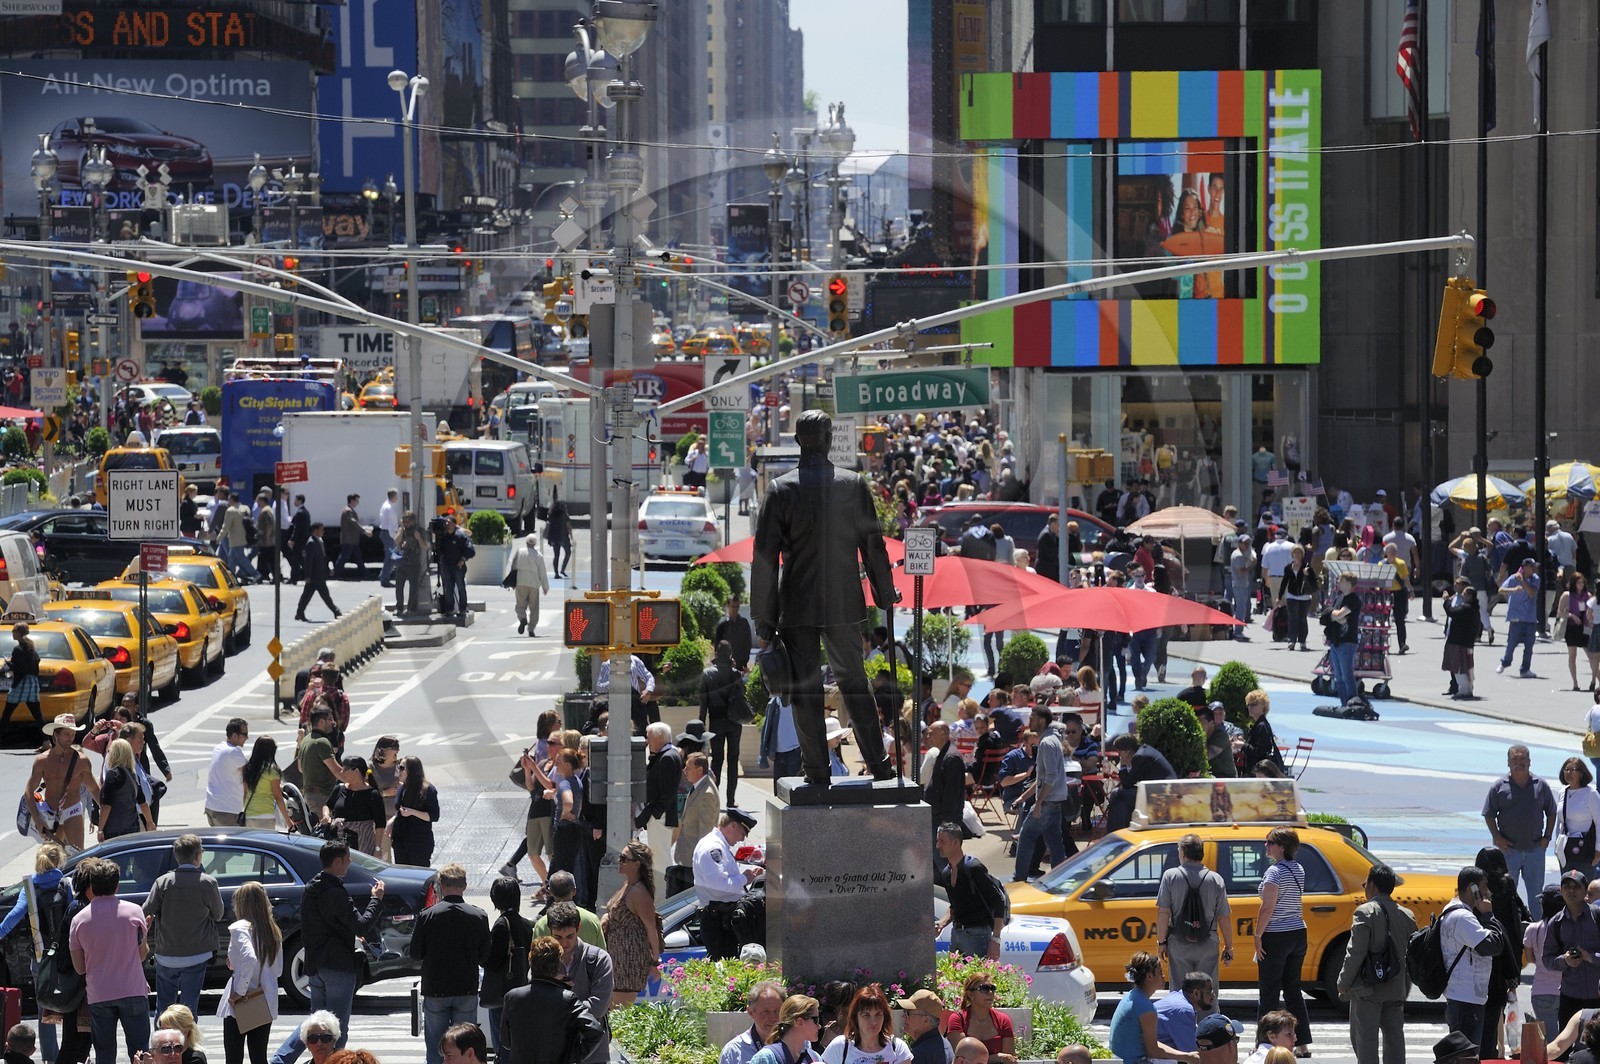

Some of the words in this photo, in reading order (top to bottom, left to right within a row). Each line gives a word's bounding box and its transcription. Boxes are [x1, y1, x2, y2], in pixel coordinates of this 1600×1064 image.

[1, 2, 60, 12] SHERWOOD
[112, 11, 170, 47] AND
[41, 73, 79, 95] All
[94, 73, 155, 96] New
[165, 73, 271, 99] Optima
[61, 190, 88, 207] EW
[105, 191, 142, 209] ORK
[591, 285, 613, 293] SECURITY
[338, 332, 394, 353] TIME
[36, 370, 60, 378] NYPD
[858, 380, 967, 405] Broadway
[238, 396, 302, 411] CitySights
[304, 396, 320, 408] NY
[711, 395, 743, 407] ONLY
[712, 431, 742, 441] Broadway
[112, 479, 143, 491] RIGHT
[148, 479, 175, 491] LANE
[126, 498, 161, 512] MUST
[112, 520, 140, 531] TURN
[144, 520, 176, 531] RIGHT
[658, 519, 693, 527] POLICE
[908, 551, 931, 561] WALK
[909, 562, 930, 571] BIKE
[457, 671, 571, 682] ONL
[809, 874, 832, 886] You're
[842, 873, 869, 885] Grand
[871, 872, 886, 882] Old
[888, 871, 907, 884] Flag
[835, 884, 856, 893] Over
[857, 883, 879, 893] There
[1084, 927, 1120, 940] NYC
[1004, 941, 1026, 952] 3446
